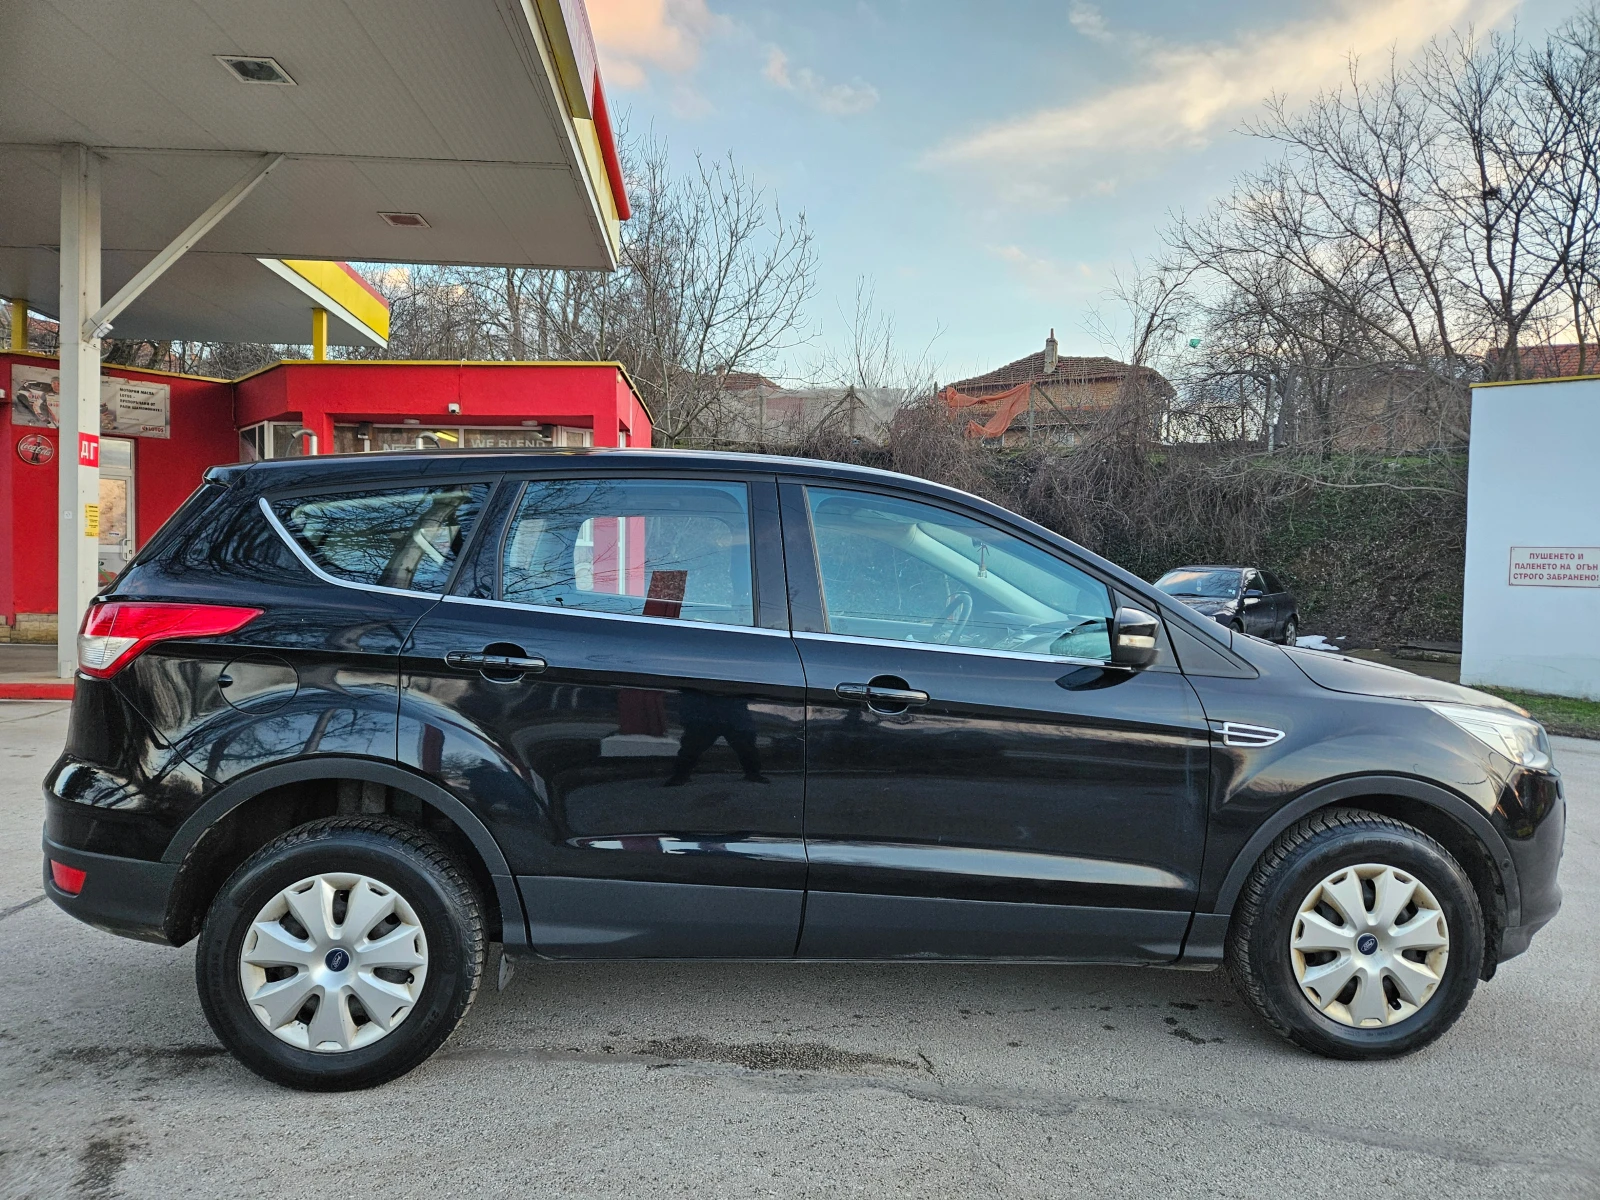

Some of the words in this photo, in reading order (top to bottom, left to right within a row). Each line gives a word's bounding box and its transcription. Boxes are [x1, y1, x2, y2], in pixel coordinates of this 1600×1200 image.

[80, 440, 99, 460] ДГ
[1529, 552, 1576, 560] ПУШЕНЕТО
[1575, 563, 1599, 571] ОГЪН
[1513, 572, 1545, 580] СТРОГО
[1546, 573, 1600, 581] ЗАБРАНЕНО!
